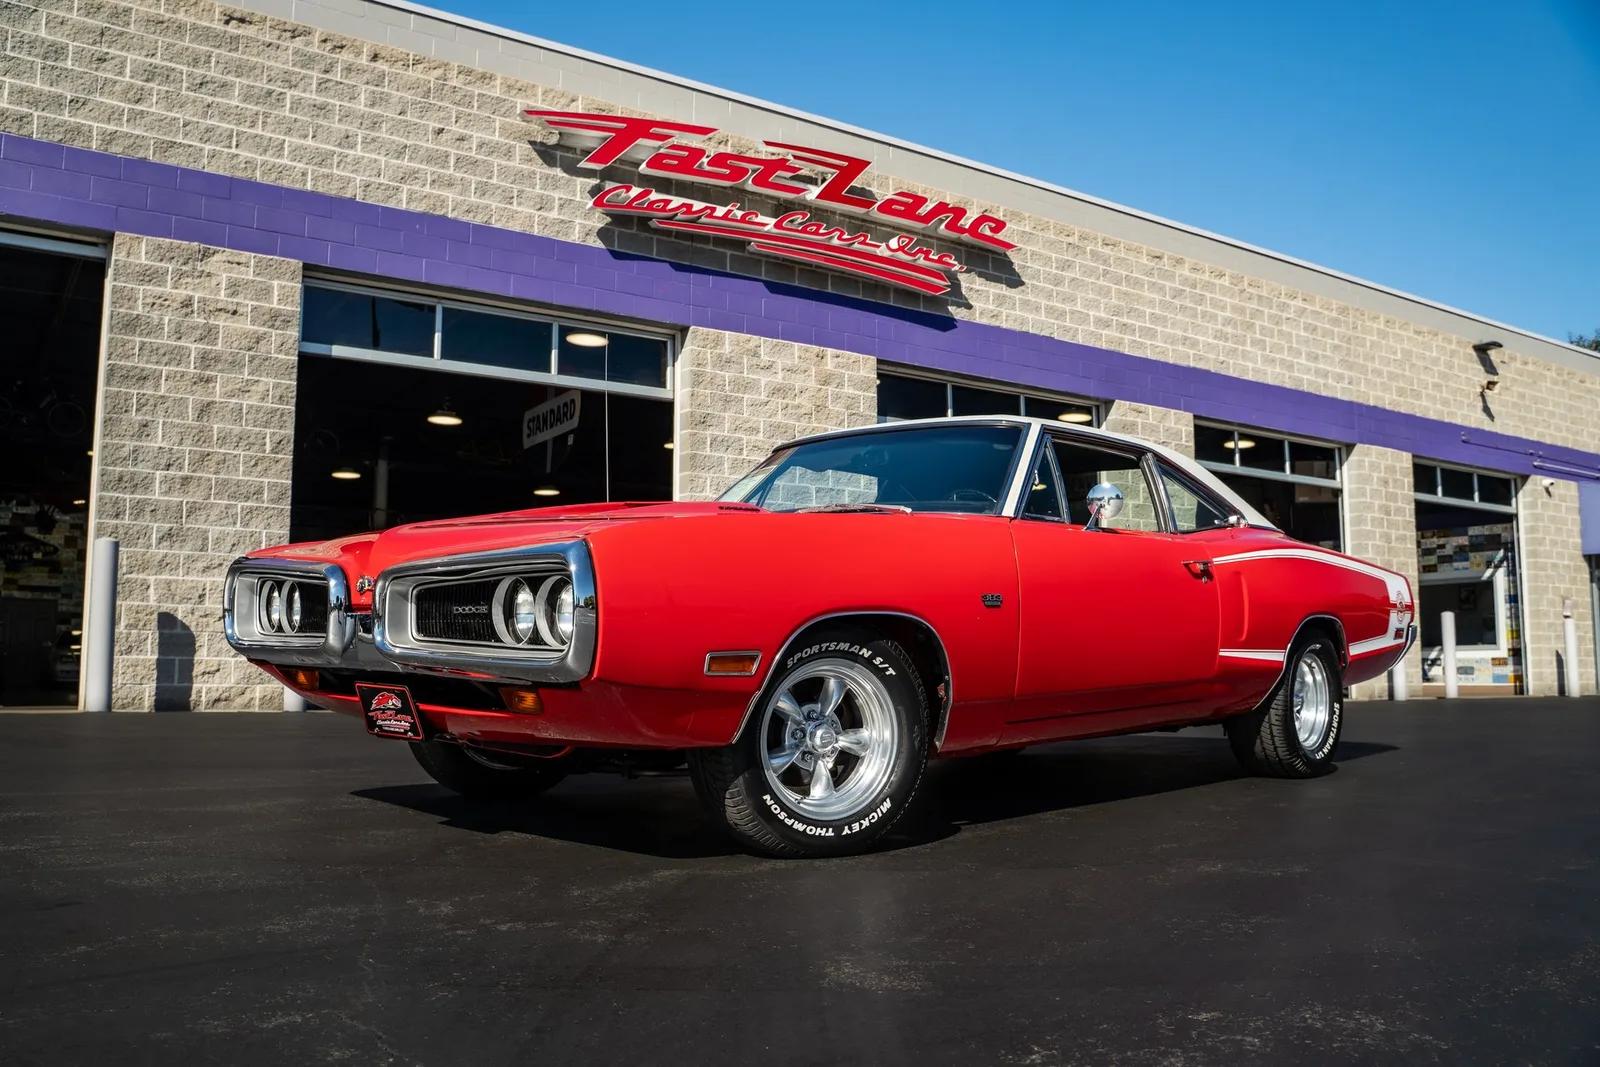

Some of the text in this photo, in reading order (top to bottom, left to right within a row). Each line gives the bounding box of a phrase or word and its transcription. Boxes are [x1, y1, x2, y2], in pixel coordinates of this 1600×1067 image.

[523, 109, 1018, 252] Fast Lane
[591, 183, 771, 230] Classic
[772, 211, 884, 250] Cars
[526, 398, 576, 439] STANDARD
[786, 641, 896, 677] SPORTSMAN S/T
[1322, 702, 1341, 756] SPORTSMAN
[762, 793, 893, 836] MICKEY THOMPSON
